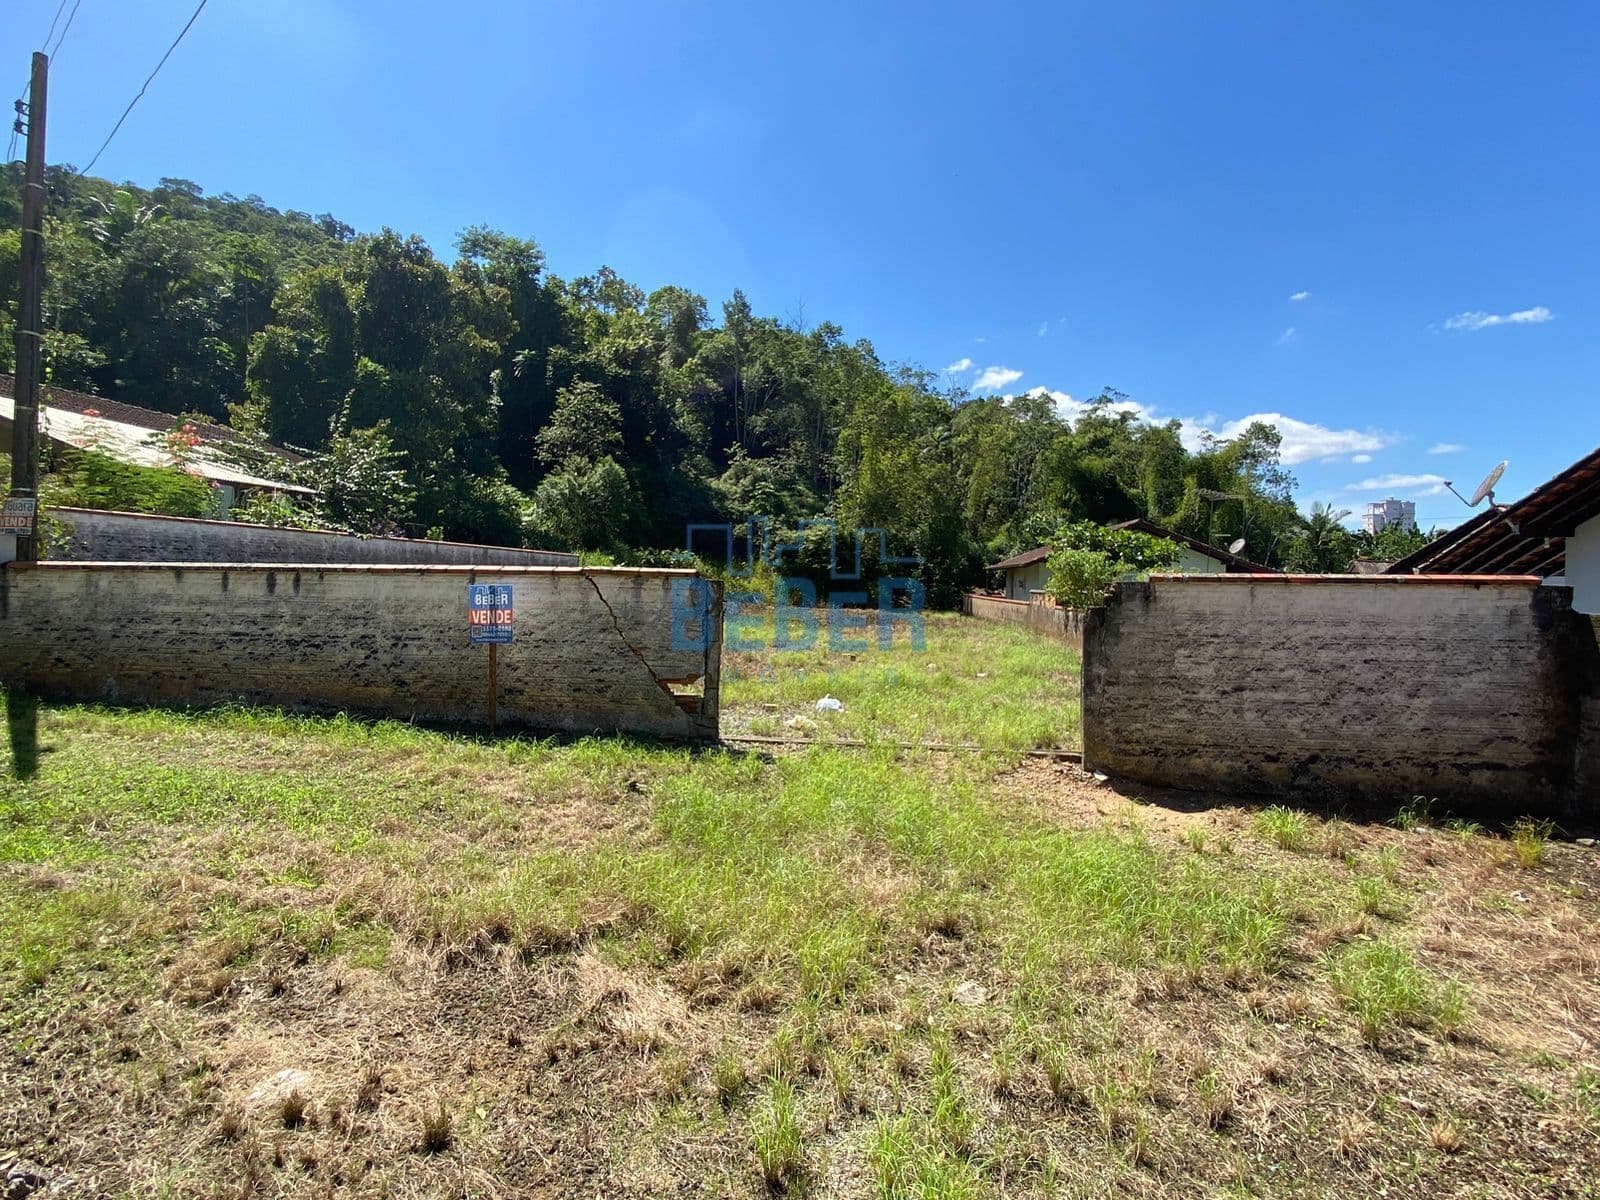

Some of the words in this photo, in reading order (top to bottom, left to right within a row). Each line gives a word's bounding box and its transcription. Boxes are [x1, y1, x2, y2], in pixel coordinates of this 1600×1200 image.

[0, 517, 33, 527] VENDE
[475, 594, 508, 605] BEBER
[472, 610, 511, 624] VENDE
